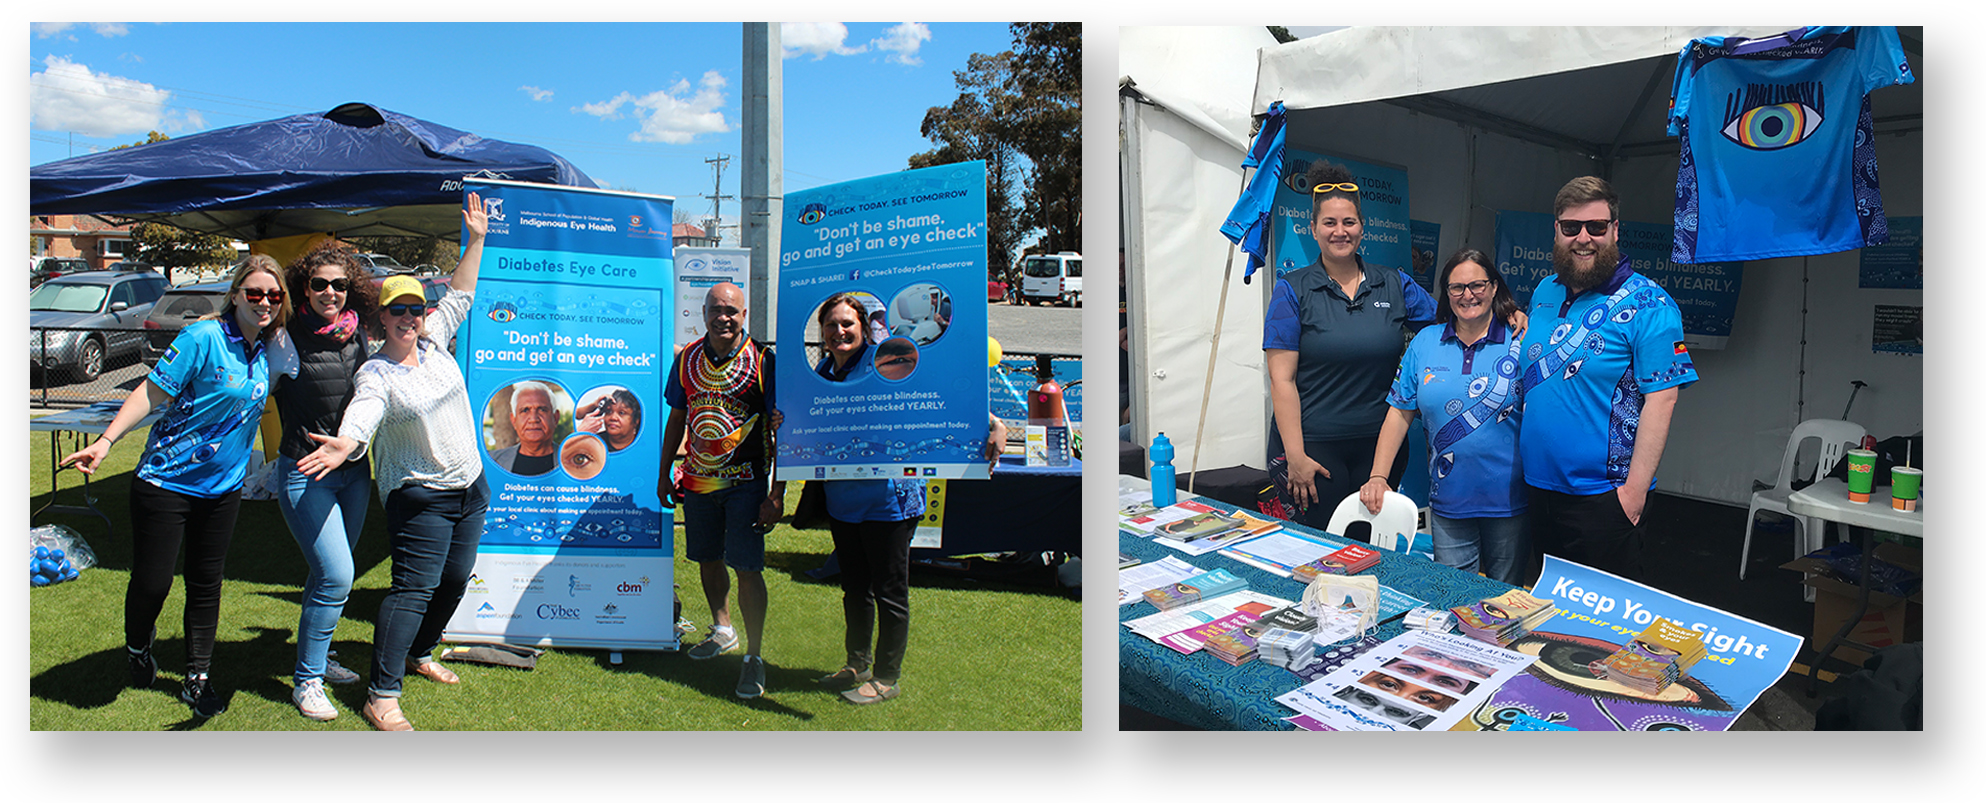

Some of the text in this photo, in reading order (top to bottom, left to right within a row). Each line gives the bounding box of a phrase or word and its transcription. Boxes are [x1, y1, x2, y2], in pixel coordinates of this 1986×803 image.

[1362, 177, 1394, 192] TODAY.
[828, 190, 968, 216] CHECK TODAY. SEE TOMORROW
[1360, 190, 1402, 206] MORROW
[520, 218, 616, 232] Indigenous Eye Health
[814, 214, 945, 242] "Don't be shame.
[1368, 217, 1408, 231] blindness.
[782, 222, 984, 266] go and get an eye check"
[1362, 230, 1398, 244] checked
[1513, 246, 1553, 261] Diabe
[498, 257, 637, 278] Diabetes Eye Care
[790, 278, 810, 288] SNAP
[1500, 262, 1526, 276] Get
[1530, 267, 1553, 280] you
[1673, 276, 1735, 292] YEARLY.
[1516, 284, 1530, 292] Ask
[519, 312, 546, 320] CHECK
[596, 316, 644, 325] TOMORROW
[504, 330, 628, 350] "Don't be shame.
[475, 348, 656, 368] go and get an eye check"
[814, 395, 848, 405] Diabetes
[894, 390, 940, 400] blindness.
[810, 401, 946, 416] Get your eyes checked YEARLY.
[504, 484, 538, 492] Diabetes
[580, 485, 620, 494] blindness.
[516, 495, 534, 503] your
[591, 496, 624, 504] YEARLY.
[616, 581, 642, 592] cbm
[536, 603, 580, 620] Cybec
[1551, 576, 1616, 613] Keep
[1692, 622, 1770, 659] Sight
[1566, 612, 1640, 638] your eye
[1660, 634, 1680, 642] eyes
[1668, 632, 1691, 640] your
[1448, 638, 1484, 652] Looking
